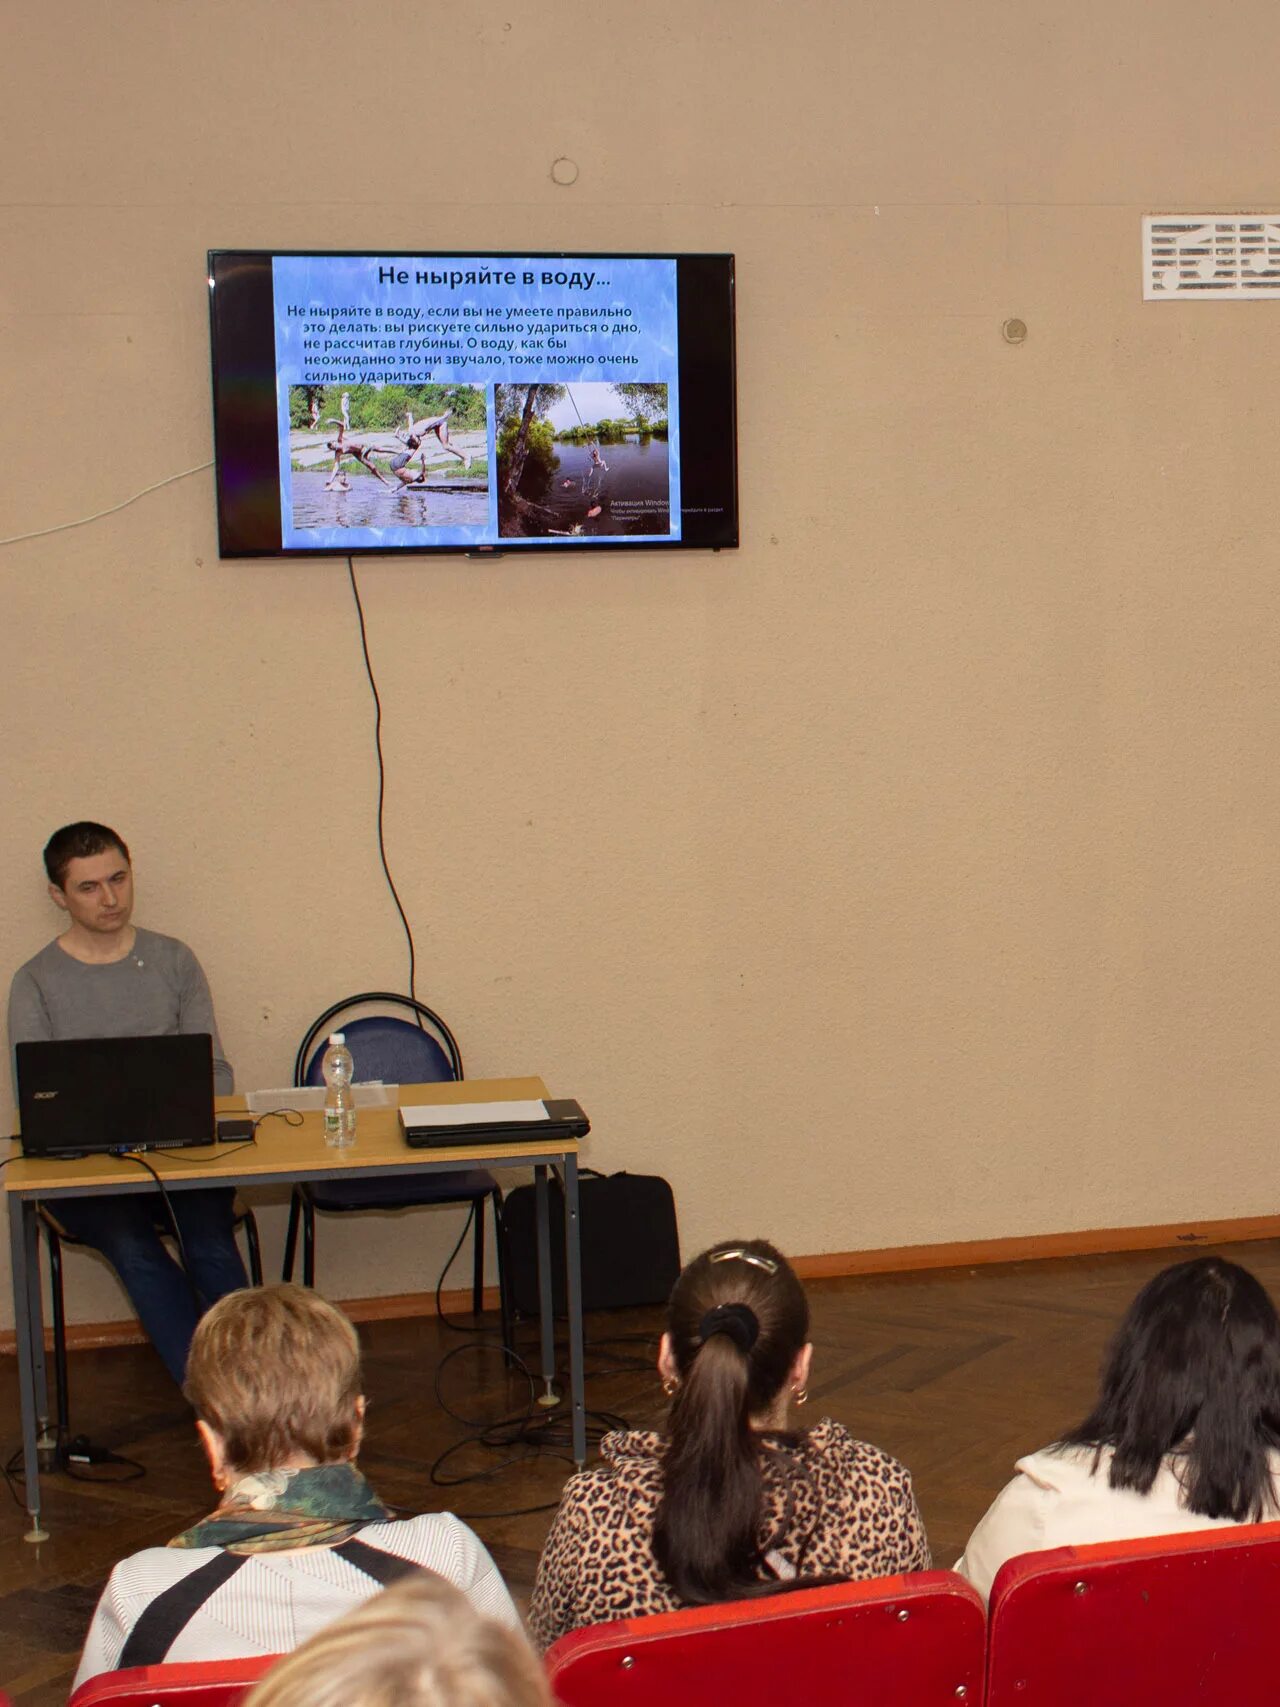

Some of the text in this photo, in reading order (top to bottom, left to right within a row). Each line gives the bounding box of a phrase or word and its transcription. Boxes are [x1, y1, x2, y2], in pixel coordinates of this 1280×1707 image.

[378, 265, 611, 290] Не ныряйте в воду...
[287, 305, 633, 320] Не ныряйте в воду, если вы не умеете правильно
[303, 323, 641, 336] это делать: вы рискуете сильно удариться о дно,
[304, 337, 567, 352] не рассчитав глубины. О воду, как бы
[304, 355, 639, 367] неожиданно это ни звучало, тоже можно очень
[305, 371, 436, 384] сильно удариться.
